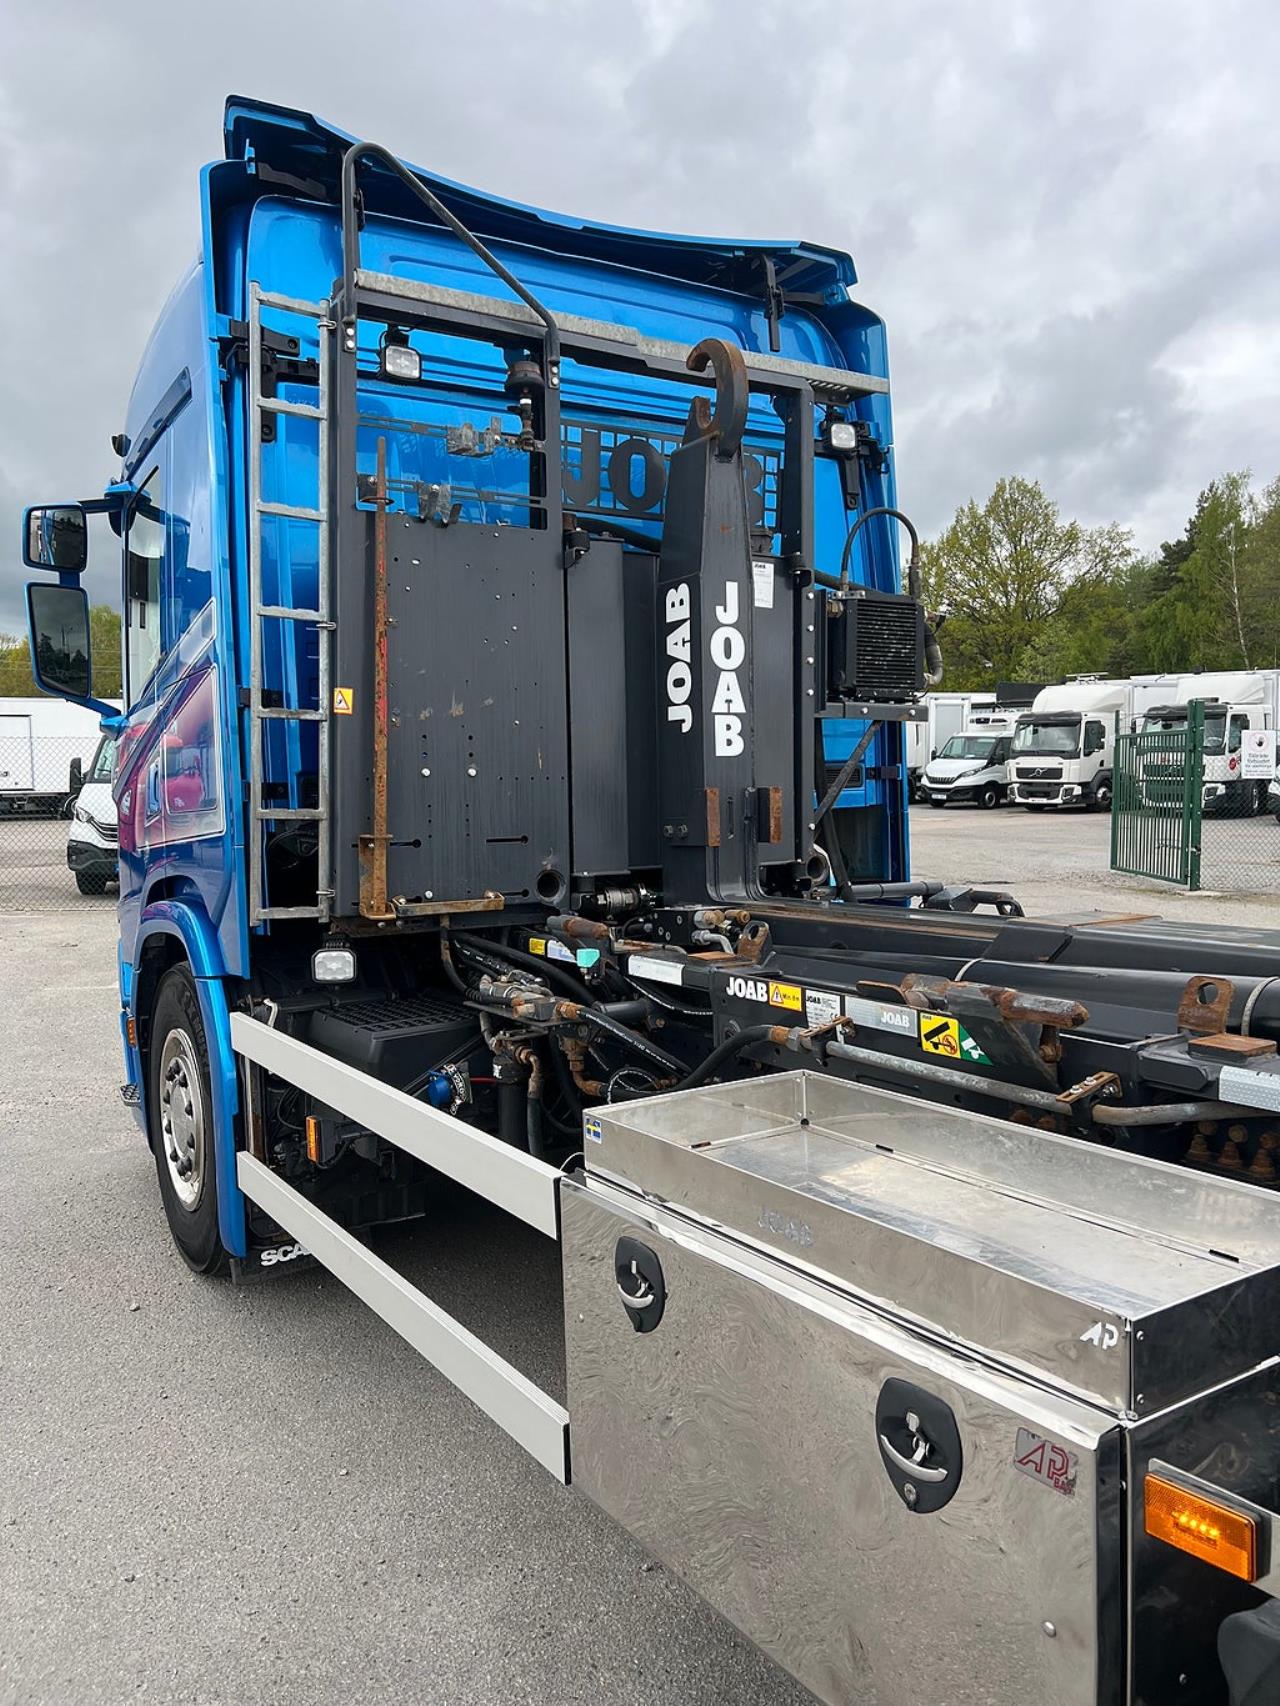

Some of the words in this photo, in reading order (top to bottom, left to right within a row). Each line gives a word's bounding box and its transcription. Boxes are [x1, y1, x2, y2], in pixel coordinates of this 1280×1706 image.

[665, 582, 692, 734] JOAB
[711, 582, 746, 757] JOAB
[727, 977, 768, 1003] JOAB
[881, 1011, 910, 1027] JOAB
[260, 1242, 311, 1267] SCA
[1080, 1320, 1119, 1350] AP
